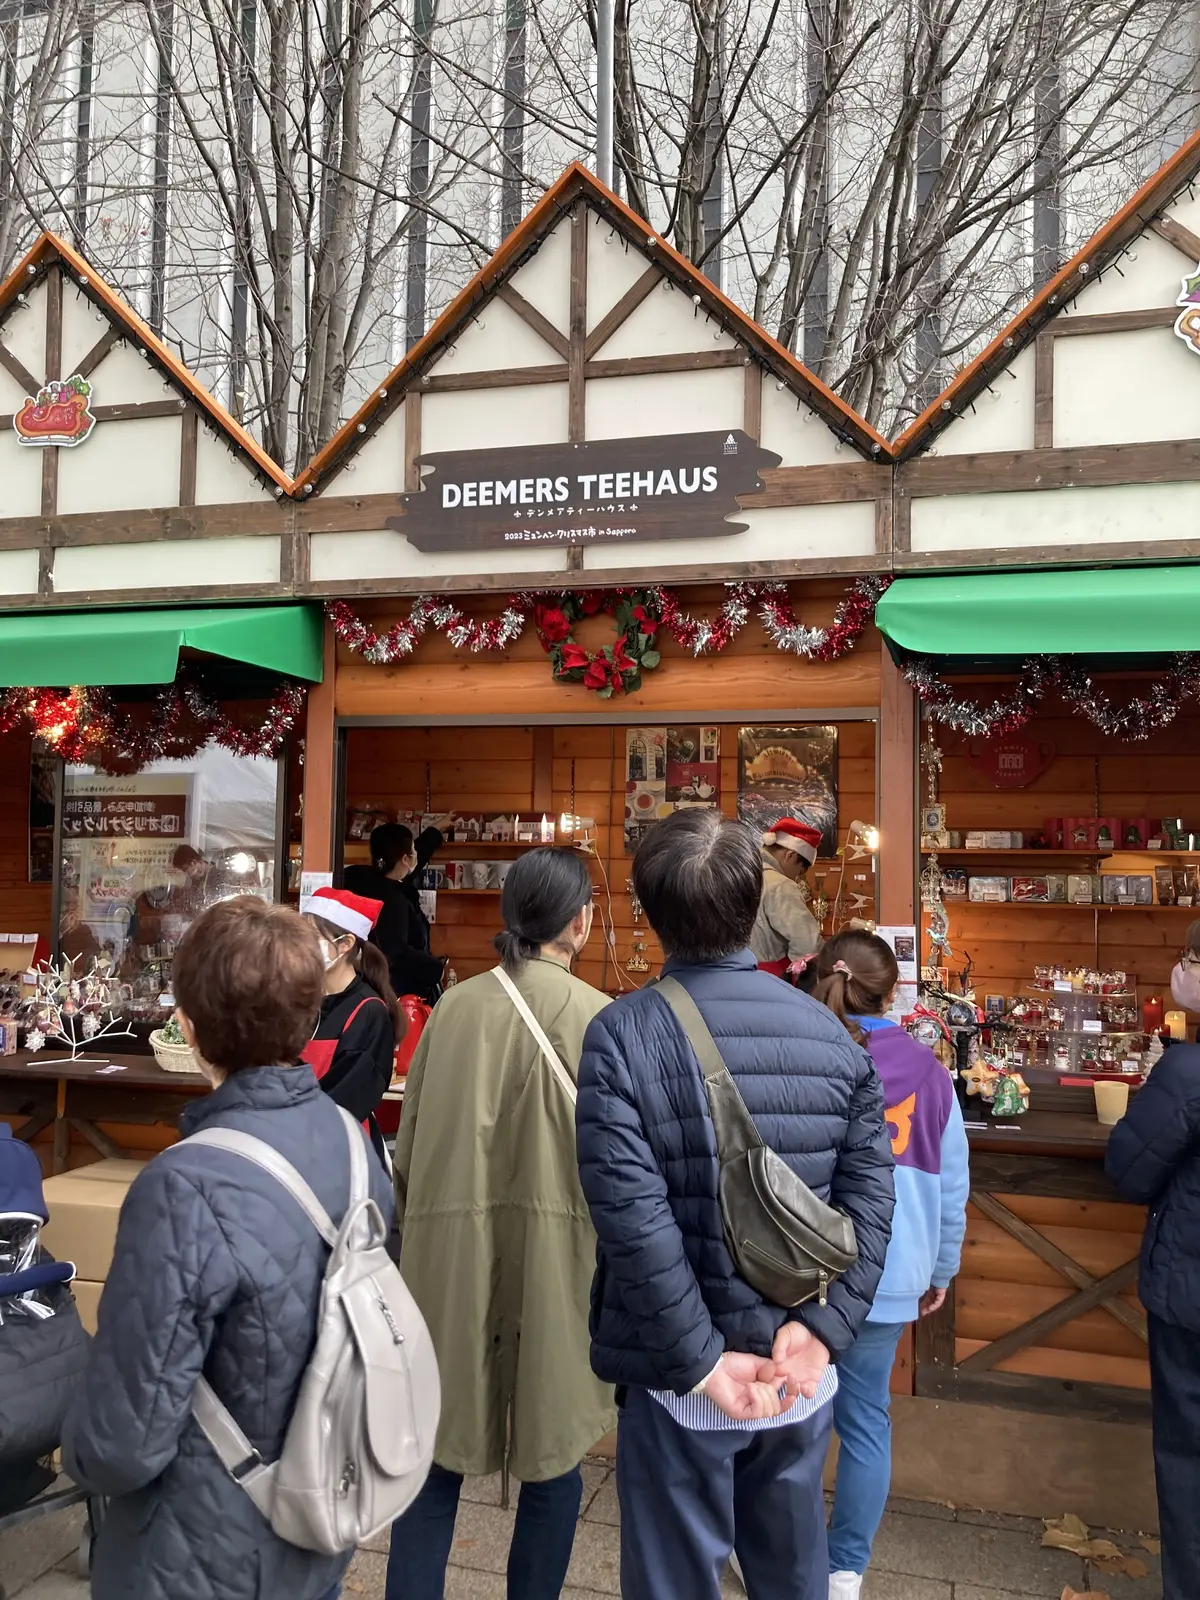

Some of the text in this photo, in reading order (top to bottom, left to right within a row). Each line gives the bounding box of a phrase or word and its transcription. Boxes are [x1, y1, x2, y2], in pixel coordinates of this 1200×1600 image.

[442, 466, 719, 508] DEEMERS TEEHAUS
[526, 503, 626, 518] デンメアティーハウス
[606, 527, 637, 537] Sapporo
